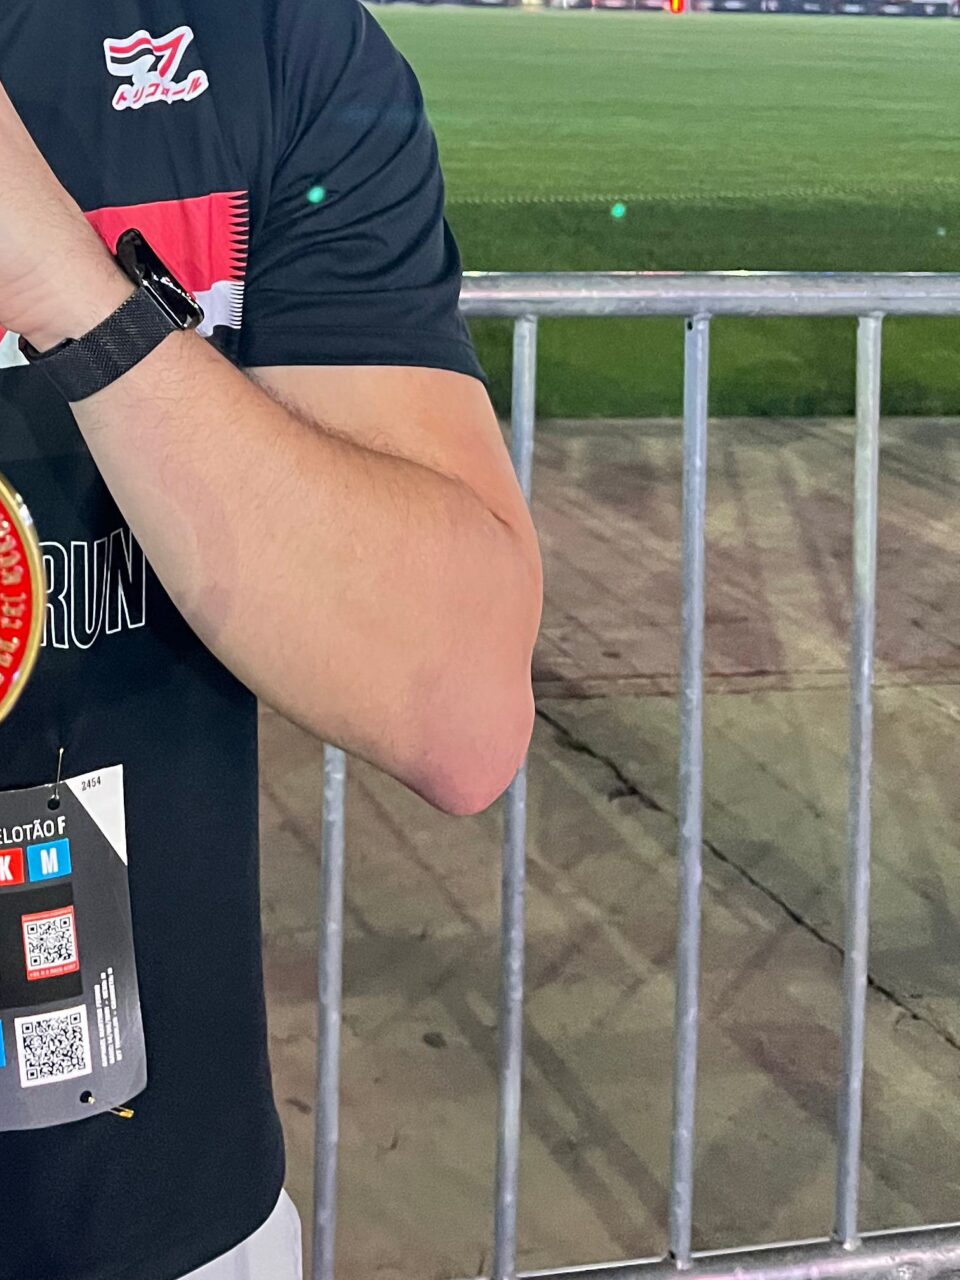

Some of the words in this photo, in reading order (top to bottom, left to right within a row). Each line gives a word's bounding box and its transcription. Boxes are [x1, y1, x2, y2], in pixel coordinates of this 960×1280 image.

[115, 75, 202, 105] トリコロール
[39, 528, 146, 650] RUN
[81, 775, 102, 792] 2454
[57, 815, 66, 835] F
[40, 847, 59, 875] M
